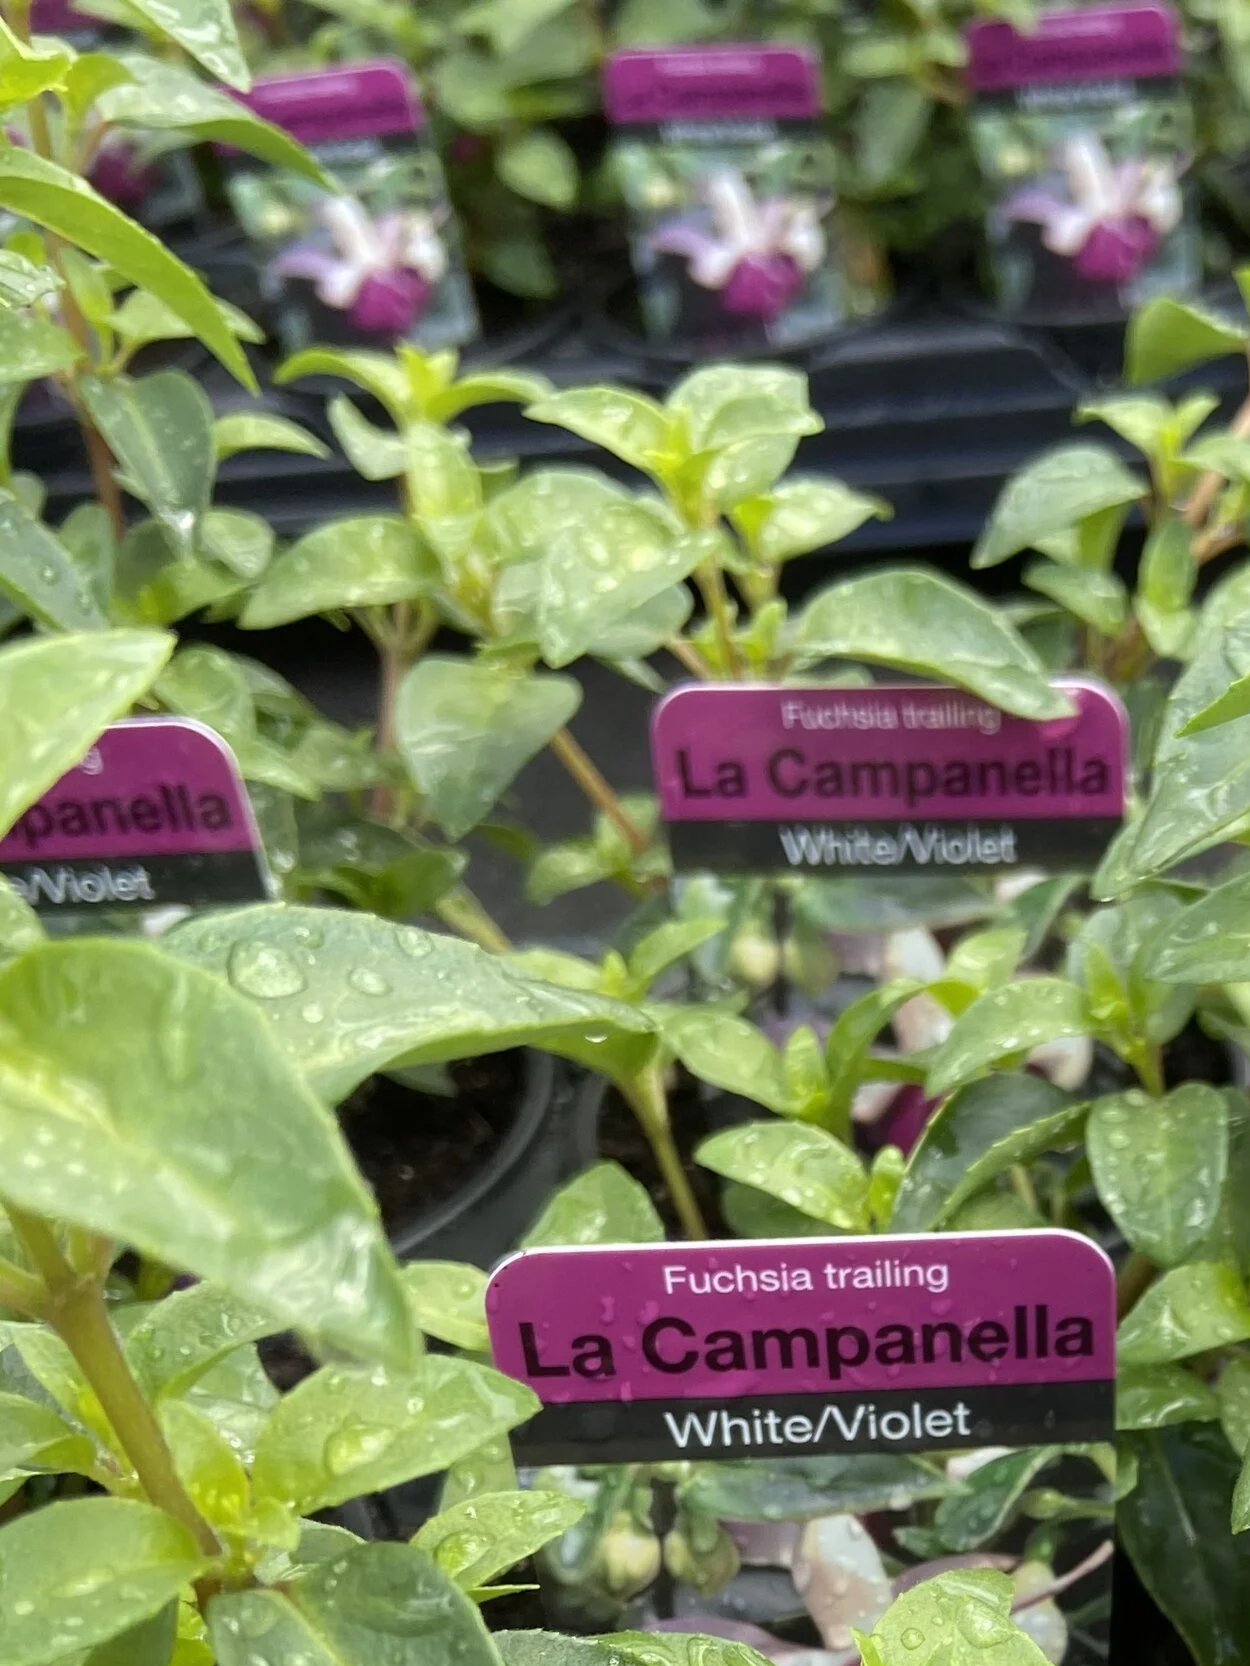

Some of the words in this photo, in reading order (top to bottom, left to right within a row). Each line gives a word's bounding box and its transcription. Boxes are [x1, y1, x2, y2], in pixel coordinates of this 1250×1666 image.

[781, 700, 898, 730] Fuchsia
[902, 700, 1002, 735] trailing
[676, 748, 746, 800] La
[766, 746, 1110, 806] Campanella
[20, 783, 230, 849] panella
[780, 825, 1018, 865] White/Violet
[663, 1262, 813, 1295] Fuchsia
[824, 1259, 950, 1292] trailing
[519, 1322, 614, 1378] La
[641, 1305, 1095, 1380] Campanella
[664, 1402, 972, 1449] White/Violet
